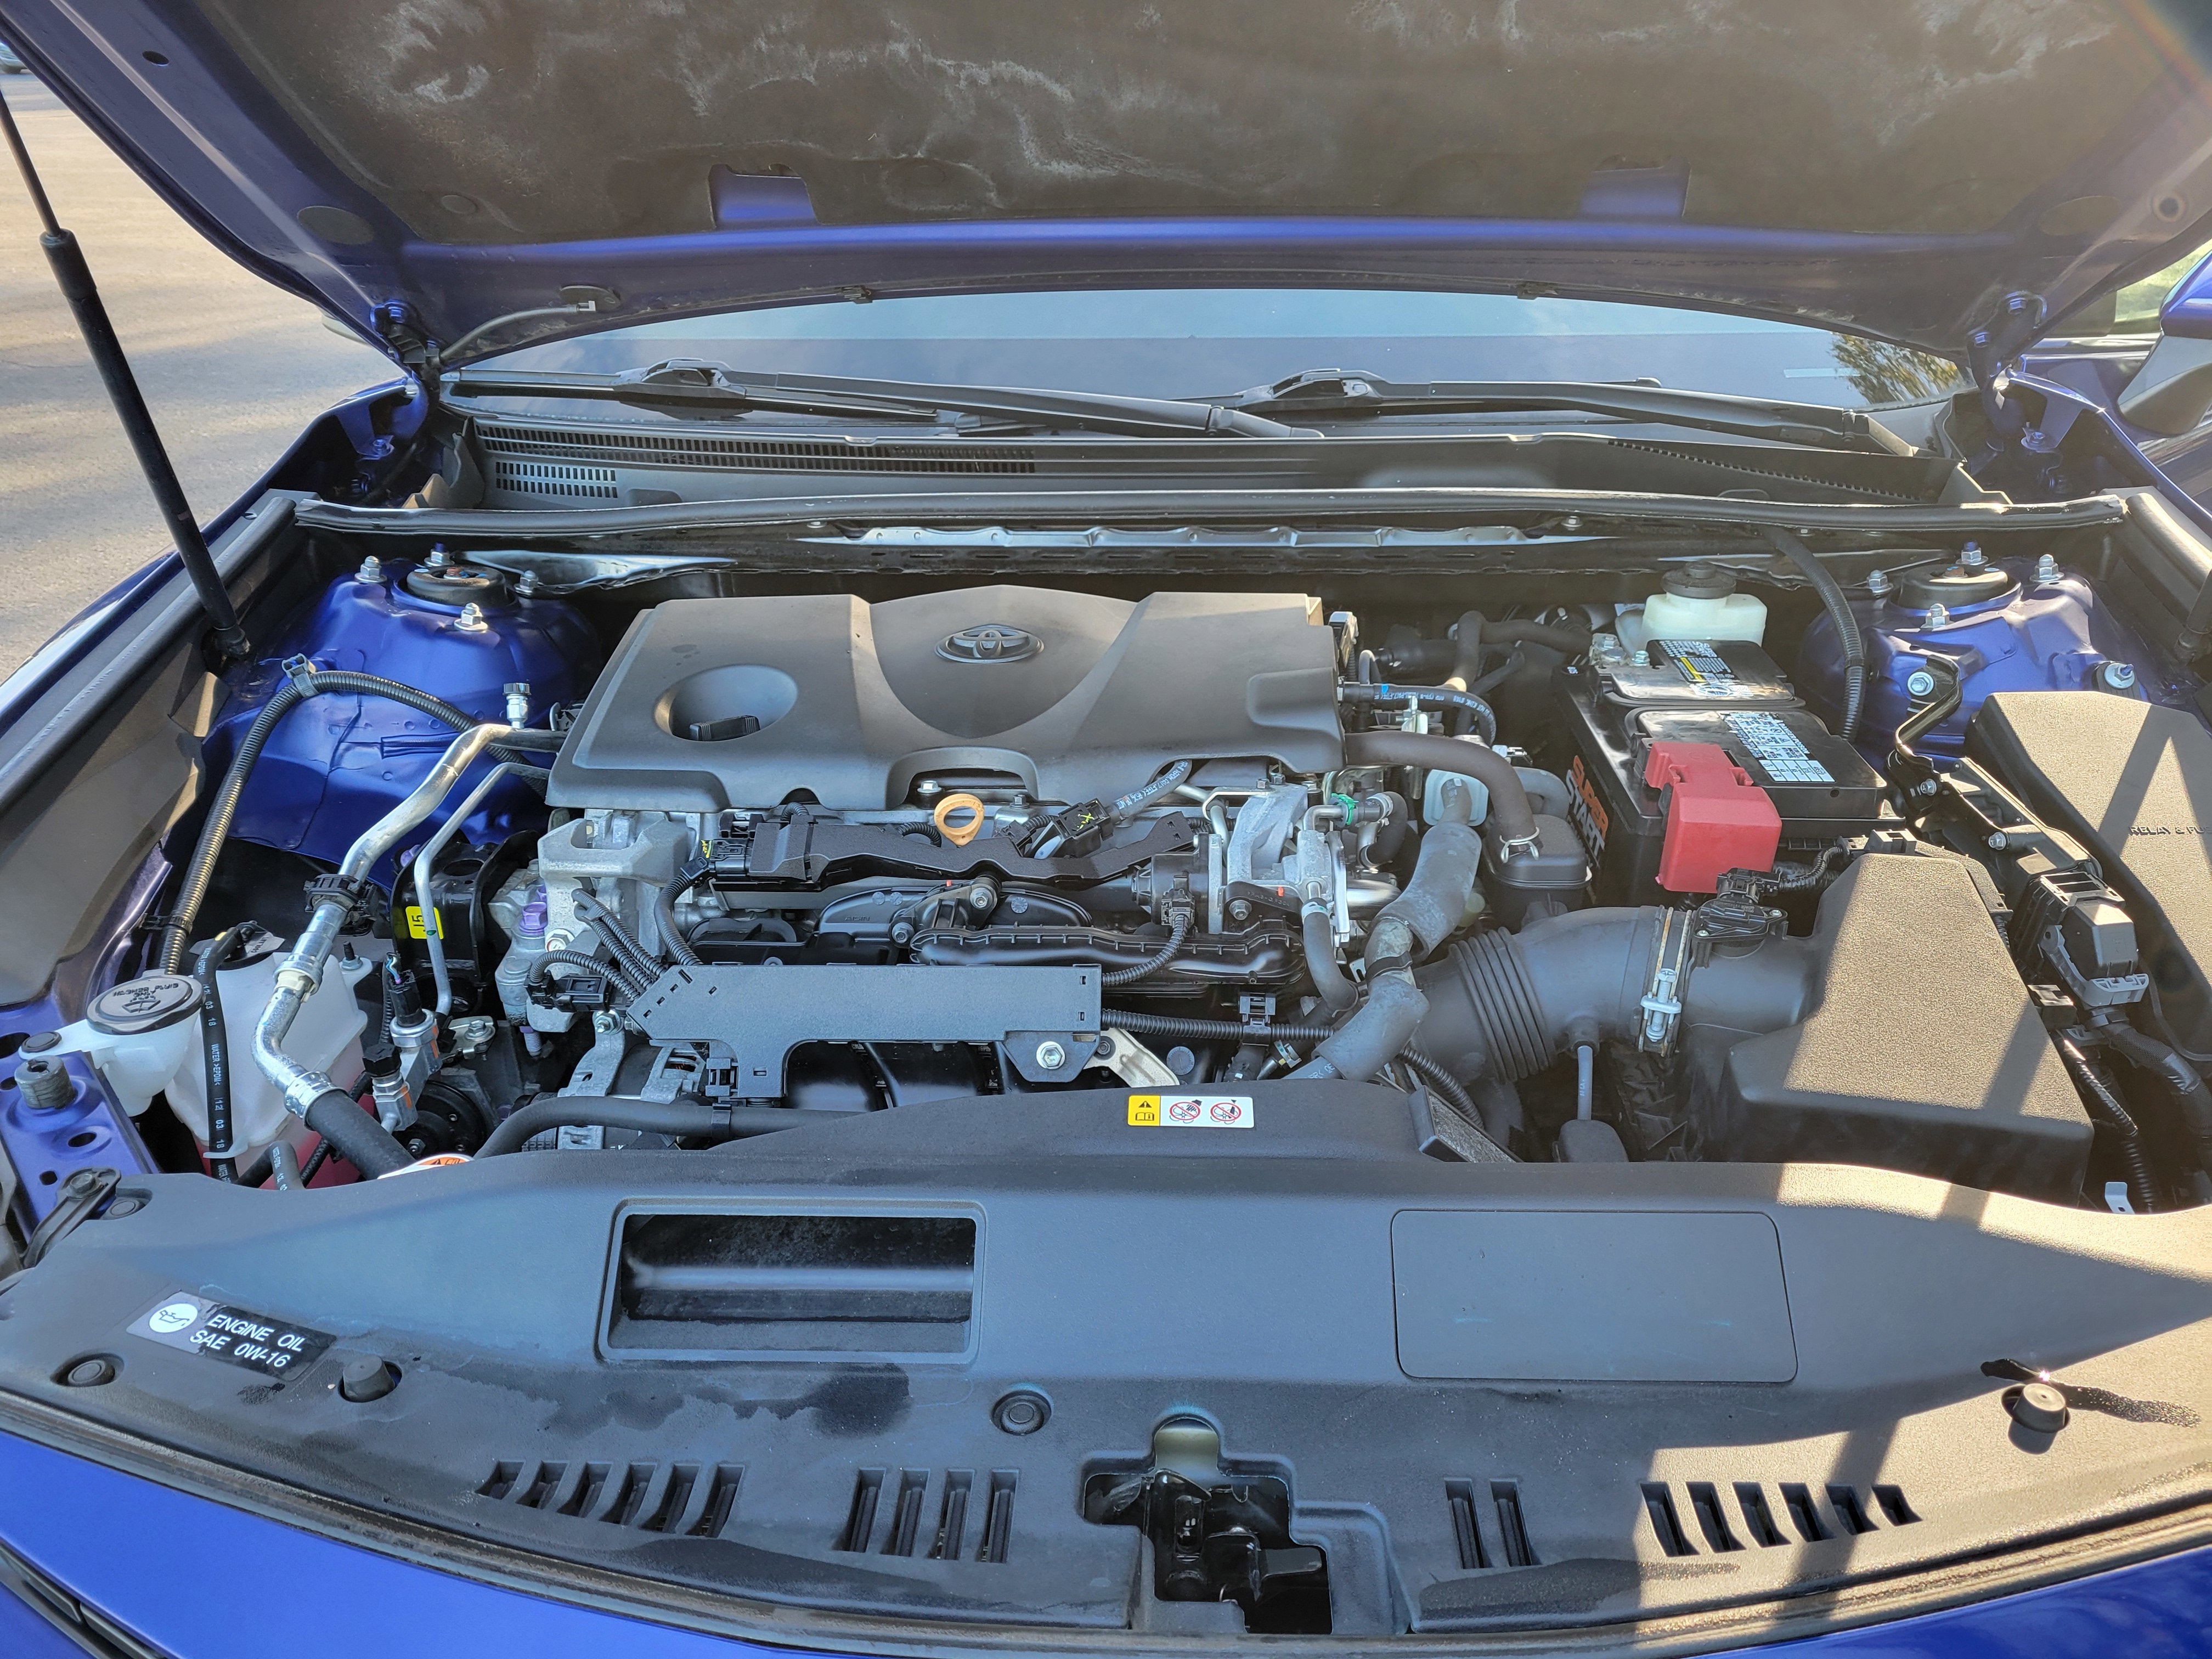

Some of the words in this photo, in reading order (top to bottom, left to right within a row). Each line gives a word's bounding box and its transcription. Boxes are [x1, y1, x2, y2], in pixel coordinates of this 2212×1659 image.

[1571, 755, 1609, 842] SUPER
[1566, 769, 1605, 857] START
[2130, 826, 2171, 836] RELAY
[155, 983, 179, 991] FLUID
[205, 1001, 214, 1009] 03
[208, 1018, 217, 1026] 18
[211, 1043, 220, 1063] WATER
[213, 1063, 221, 1086] >EPDM<
[216, 1139, 224, 1149] 18
[218, 1164, 228, 1178] WATER
[207, 1314, 274, 1341] ENGINE
[276, 1334, 307, 1352] OIL
[189, 1330, 232, 1350] SAE
[234, 1342, 292, 1368] 0W-16
